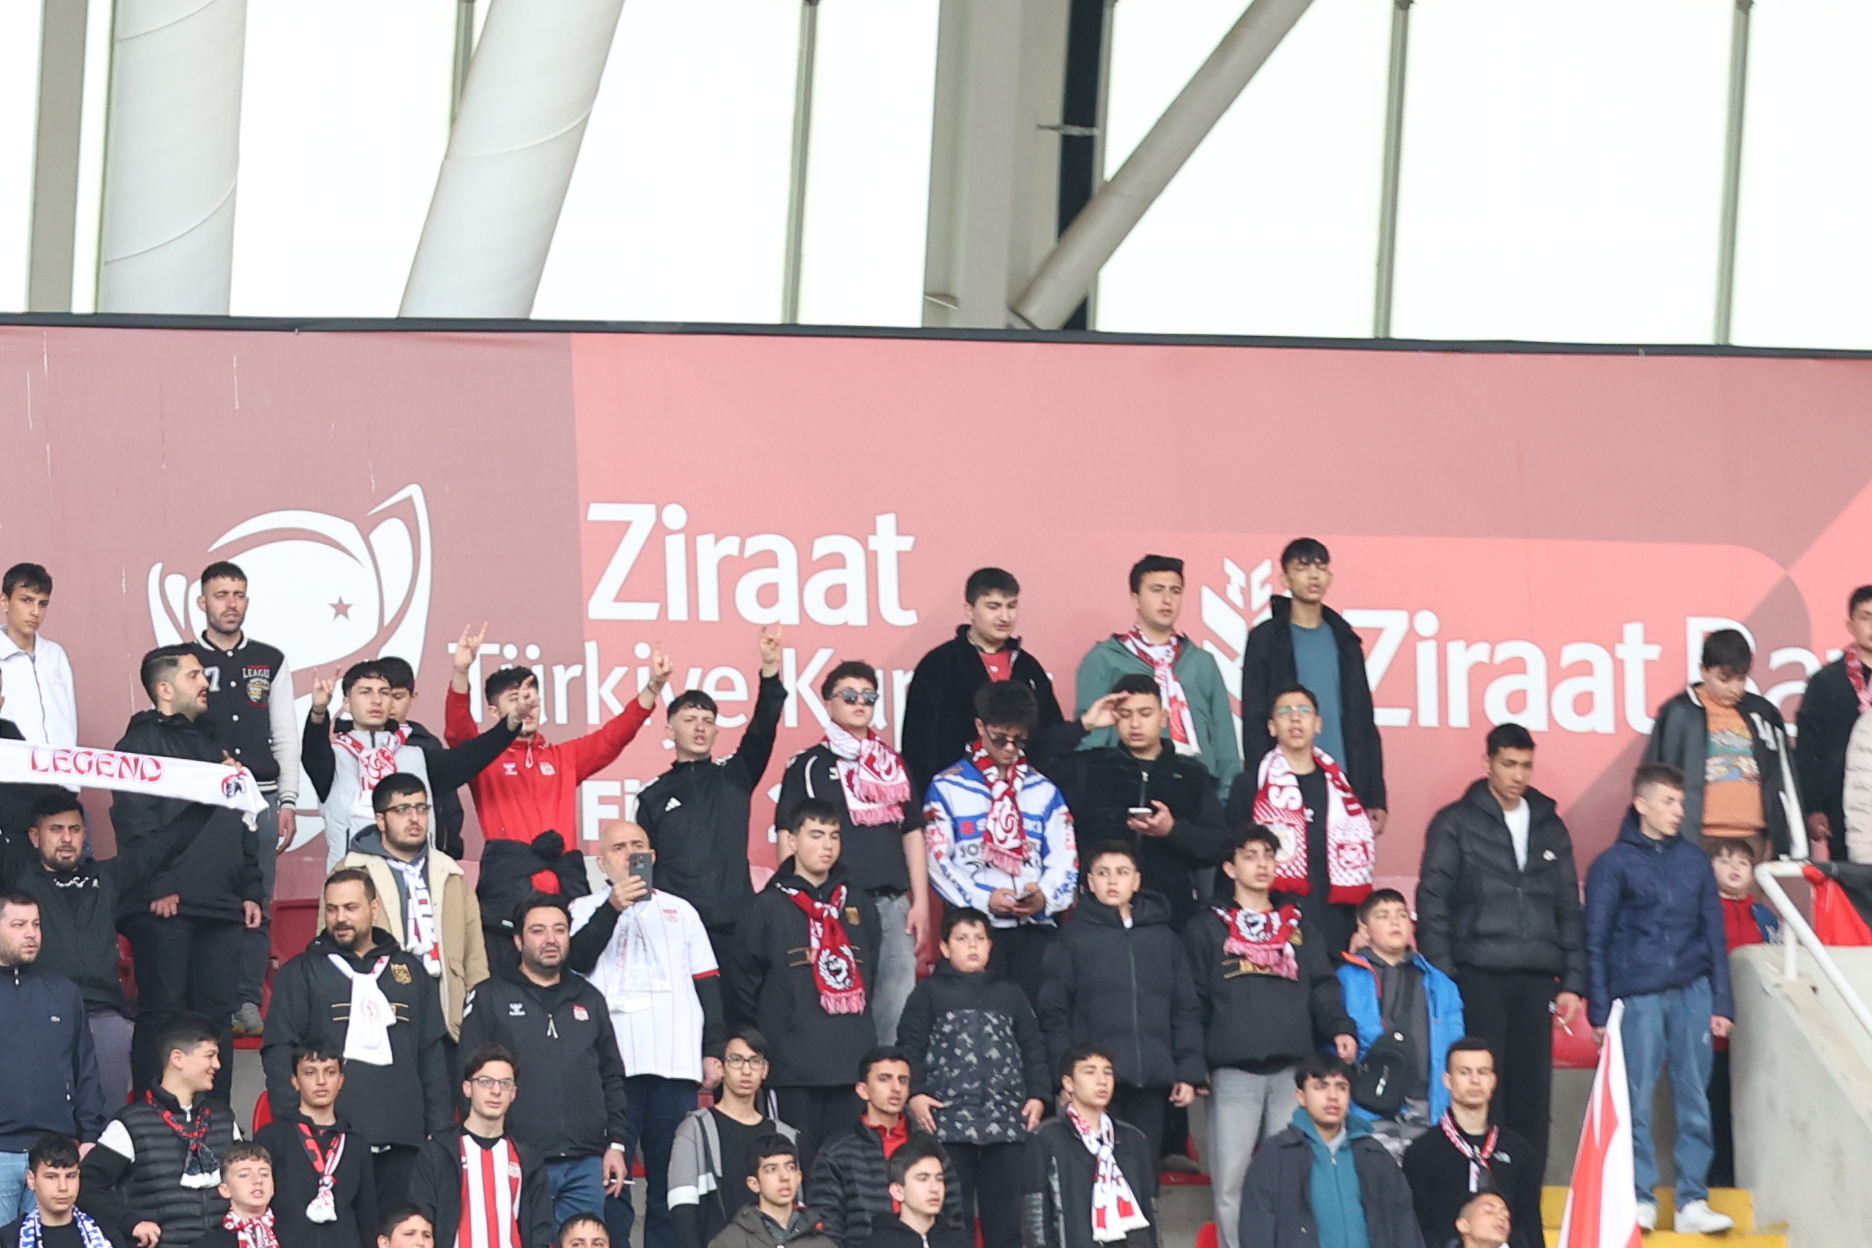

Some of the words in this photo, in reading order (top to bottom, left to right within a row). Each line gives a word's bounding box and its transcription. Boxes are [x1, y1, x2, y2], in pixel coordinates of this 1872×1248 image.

[587, 502, 918, 627] Ziraat
[1338, 608, 1663, 735] Ziraat
[28, 743, 166, 784] LEGEND
